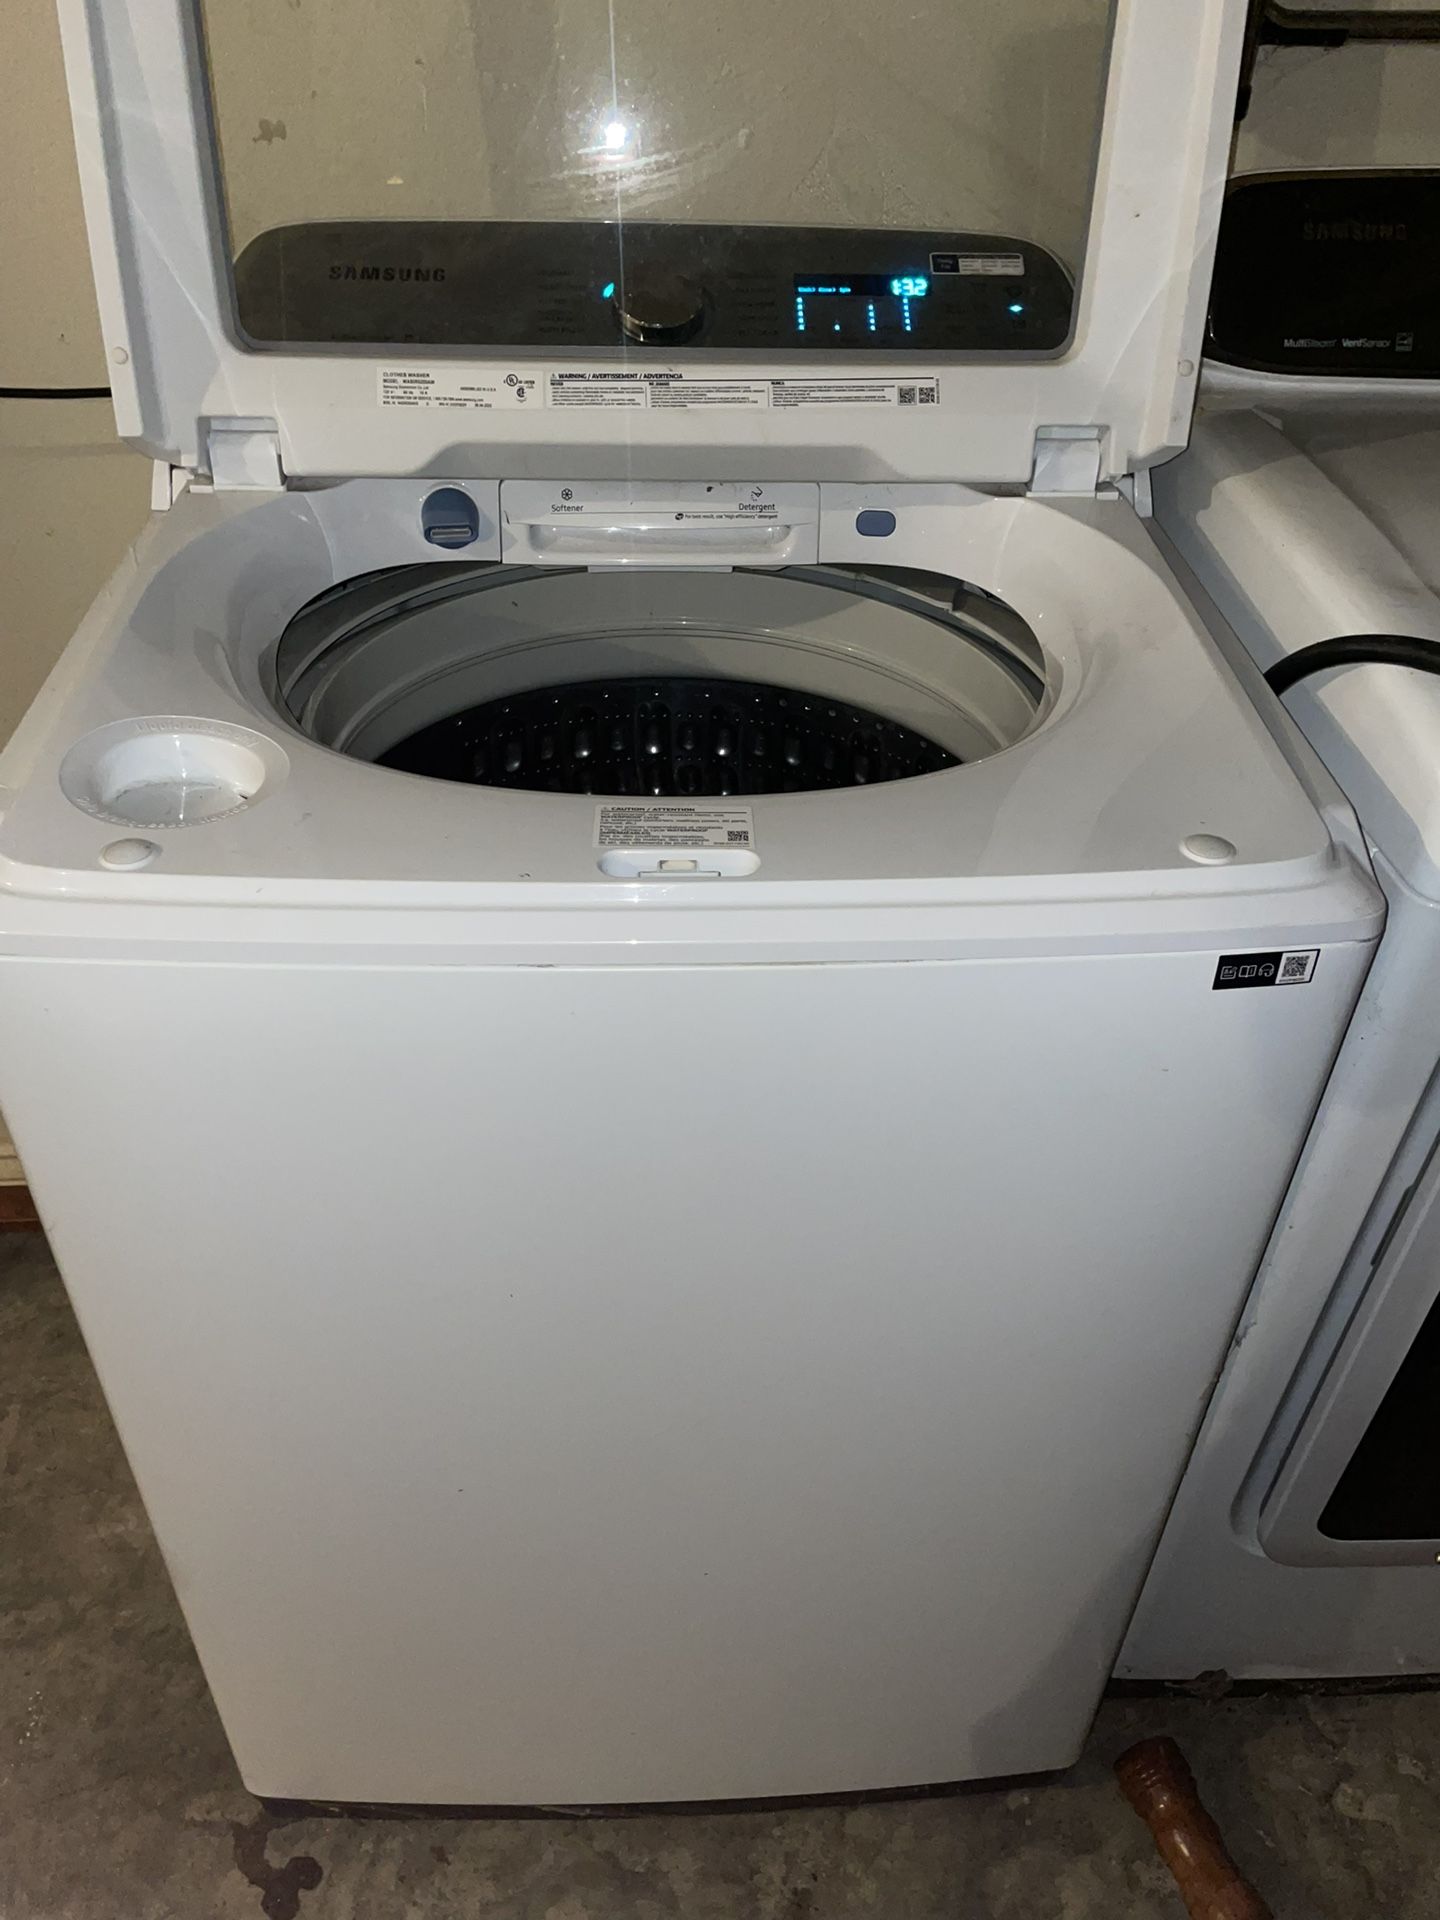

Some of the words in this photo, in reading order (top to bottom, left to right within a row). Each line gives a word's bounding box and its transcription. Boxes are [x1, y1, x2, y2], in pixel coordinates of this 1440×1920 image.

[1303, 224, 1407, 240] SAMSUNG
[328, 265, 446, 282] SAMSUNG
[891, 277, 928, 296] 1:32
[551, 504, 584, 512] Softener
[738, 503, 776, 513] Detergent
